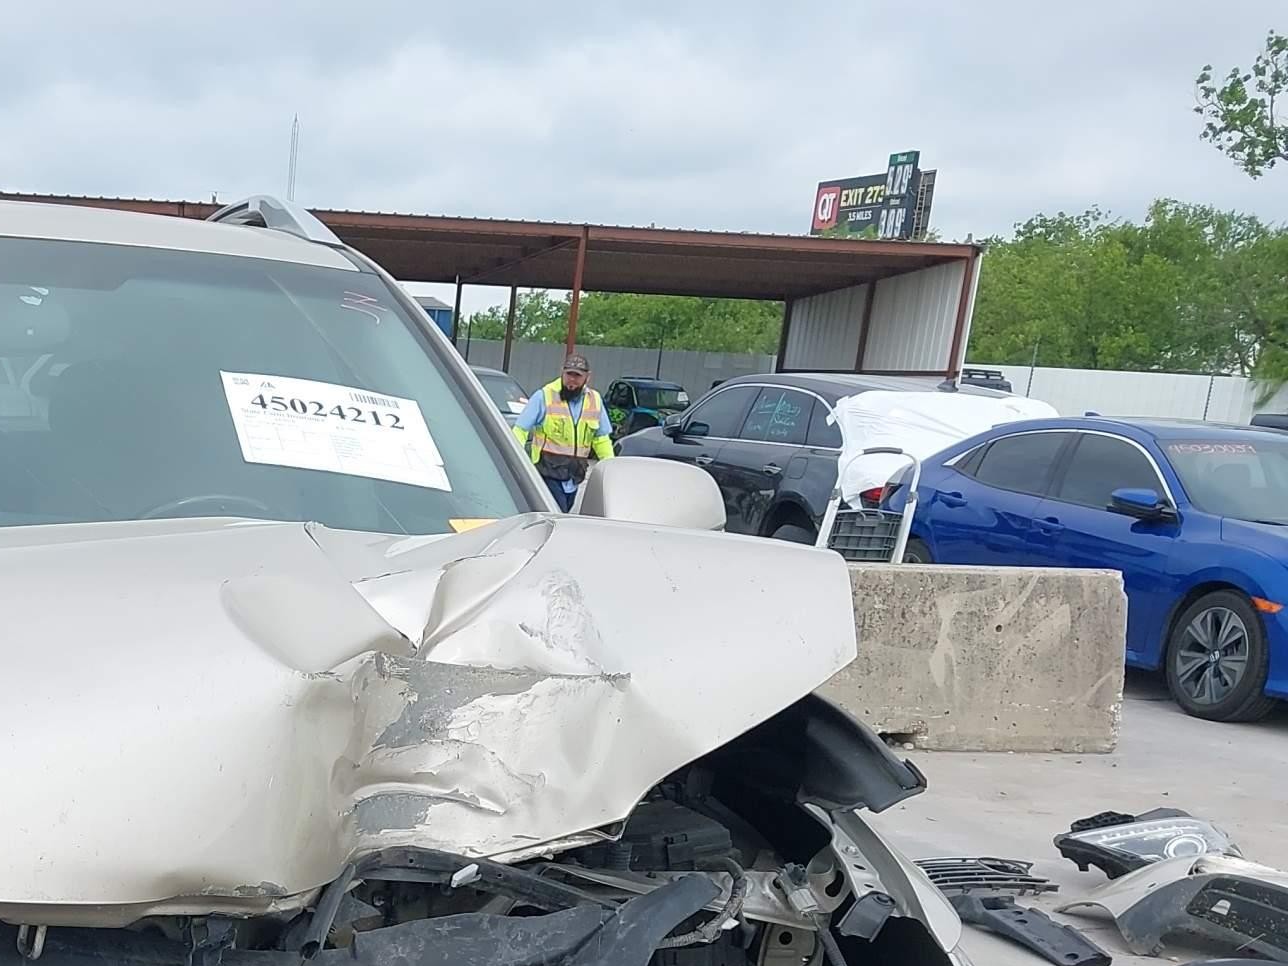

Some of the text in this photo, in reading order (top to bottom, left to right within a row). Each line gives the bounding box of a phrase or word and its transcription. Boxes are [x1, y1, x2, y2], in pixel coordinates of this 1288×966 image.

[818, 194, 835, 222] QT
[840, 188, 864, 207] EXIT
[856, 210, 872, 221] MILES
[251, 394, 405, 430] 45024212
